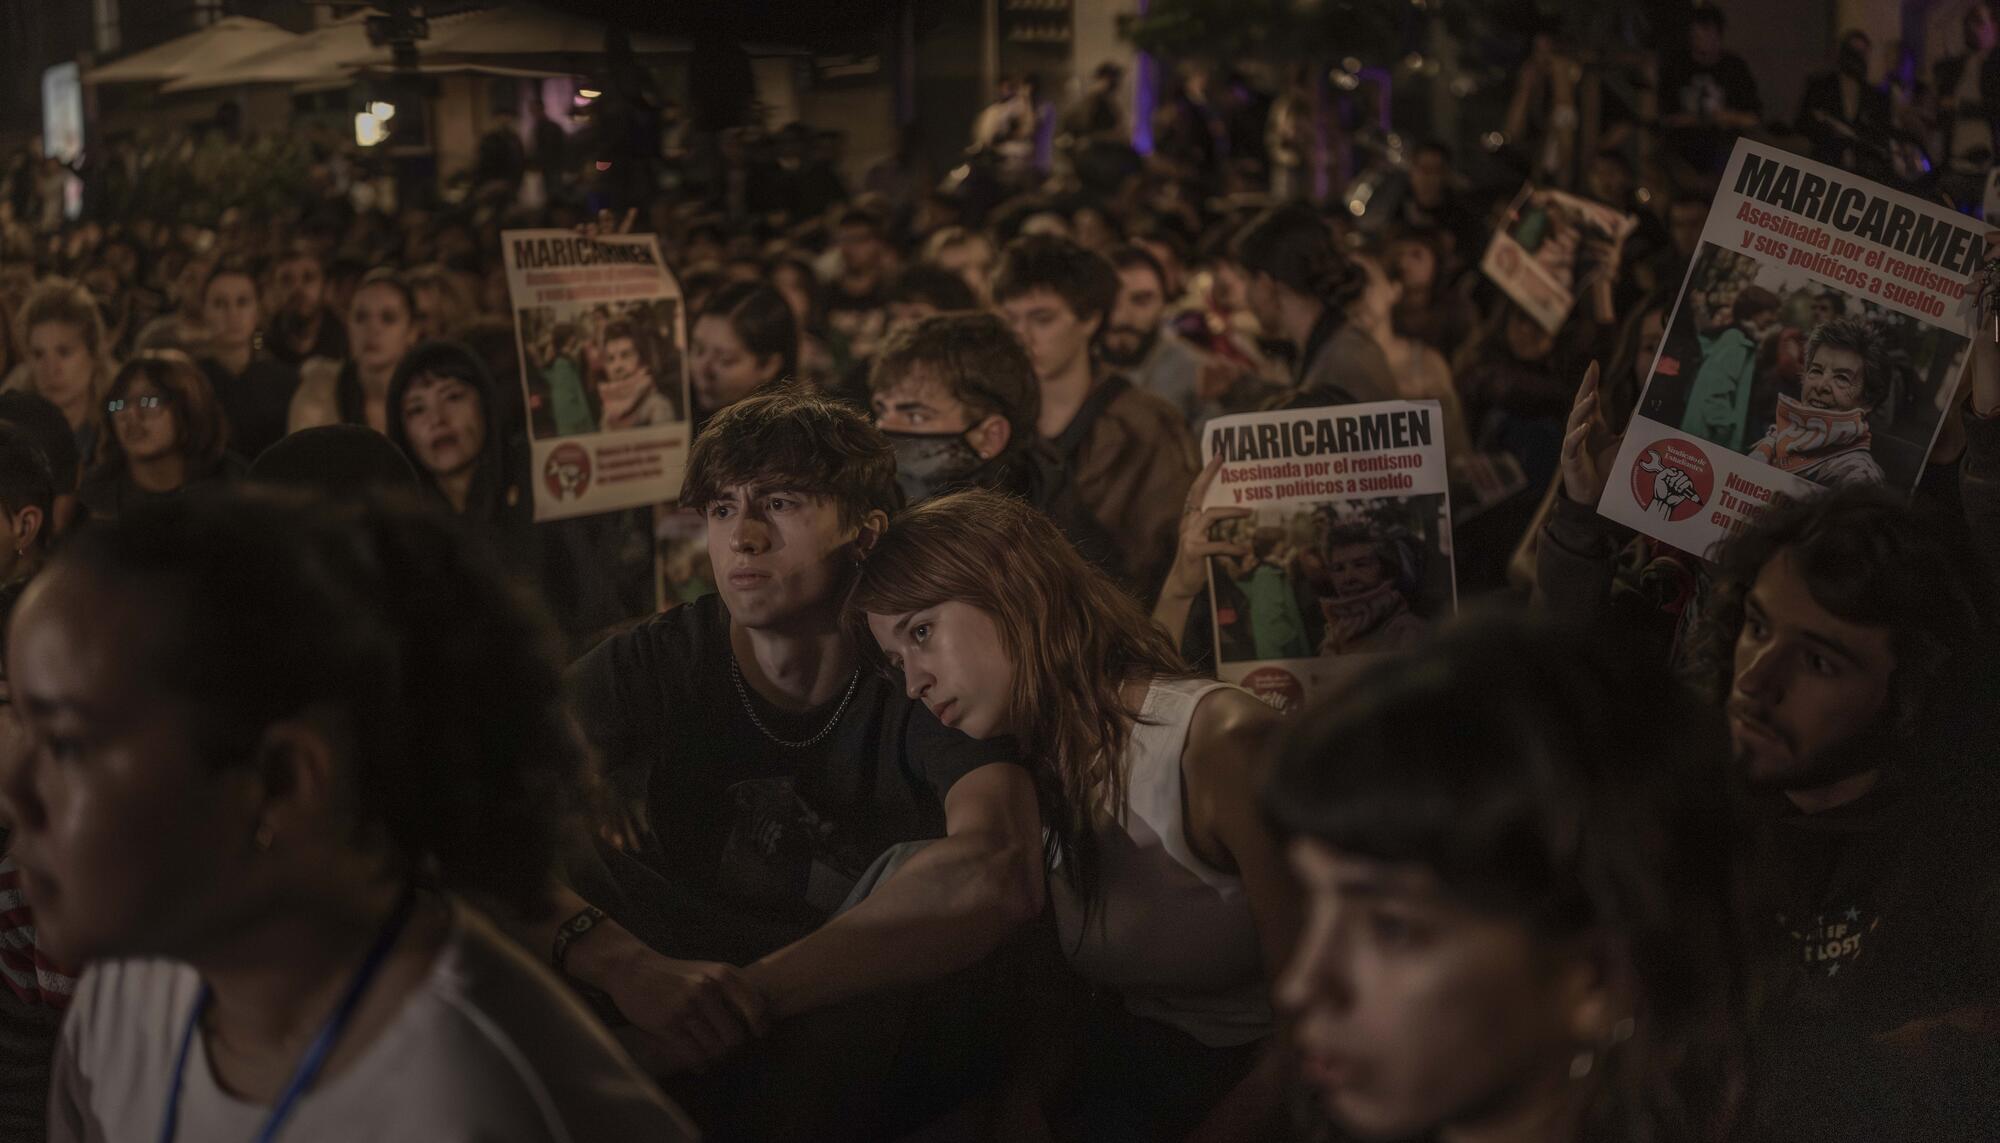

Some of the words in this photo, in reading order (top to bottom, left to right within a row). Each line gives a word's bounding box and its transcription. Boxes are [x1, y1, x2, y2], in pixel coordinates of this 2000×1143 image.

[1736, 201, 1831, 251] Asesinada
[1831, 238, 1866, 263] por
[1865, 250, 1885, 271] el
[1884, 256, 1966, 300] rentismo
[1740, 230, 1755, 249] y
[1755, 235, 1788, 260] sus
[1788, 246, 1868, 289] políticos
[1868, 277, 1883, 294] a
[1883, 281, 1946, 318] sueldo
[1211, 409, 1432, 463] MARICARMEN
[1221, 460, 1301, 484] Asesinada
[1304, 461, 1331, 480] por
[1334, 457, 1348, 474] el
[1351, 453, 1423, 473] rentismo
[1233, 487, 1243, 503] y
[1245, 484, 1273, 500] sus
[1346, 479, 1357, 492] a
[1359, 472, 1413, 491] sueldo
[1720, 490, 1738, 510] Tu
[1725, 471, 1772, 503] Nunca
[1711, 511, 1731, 529] en
[1817, 933, 1862, 961] LOST
